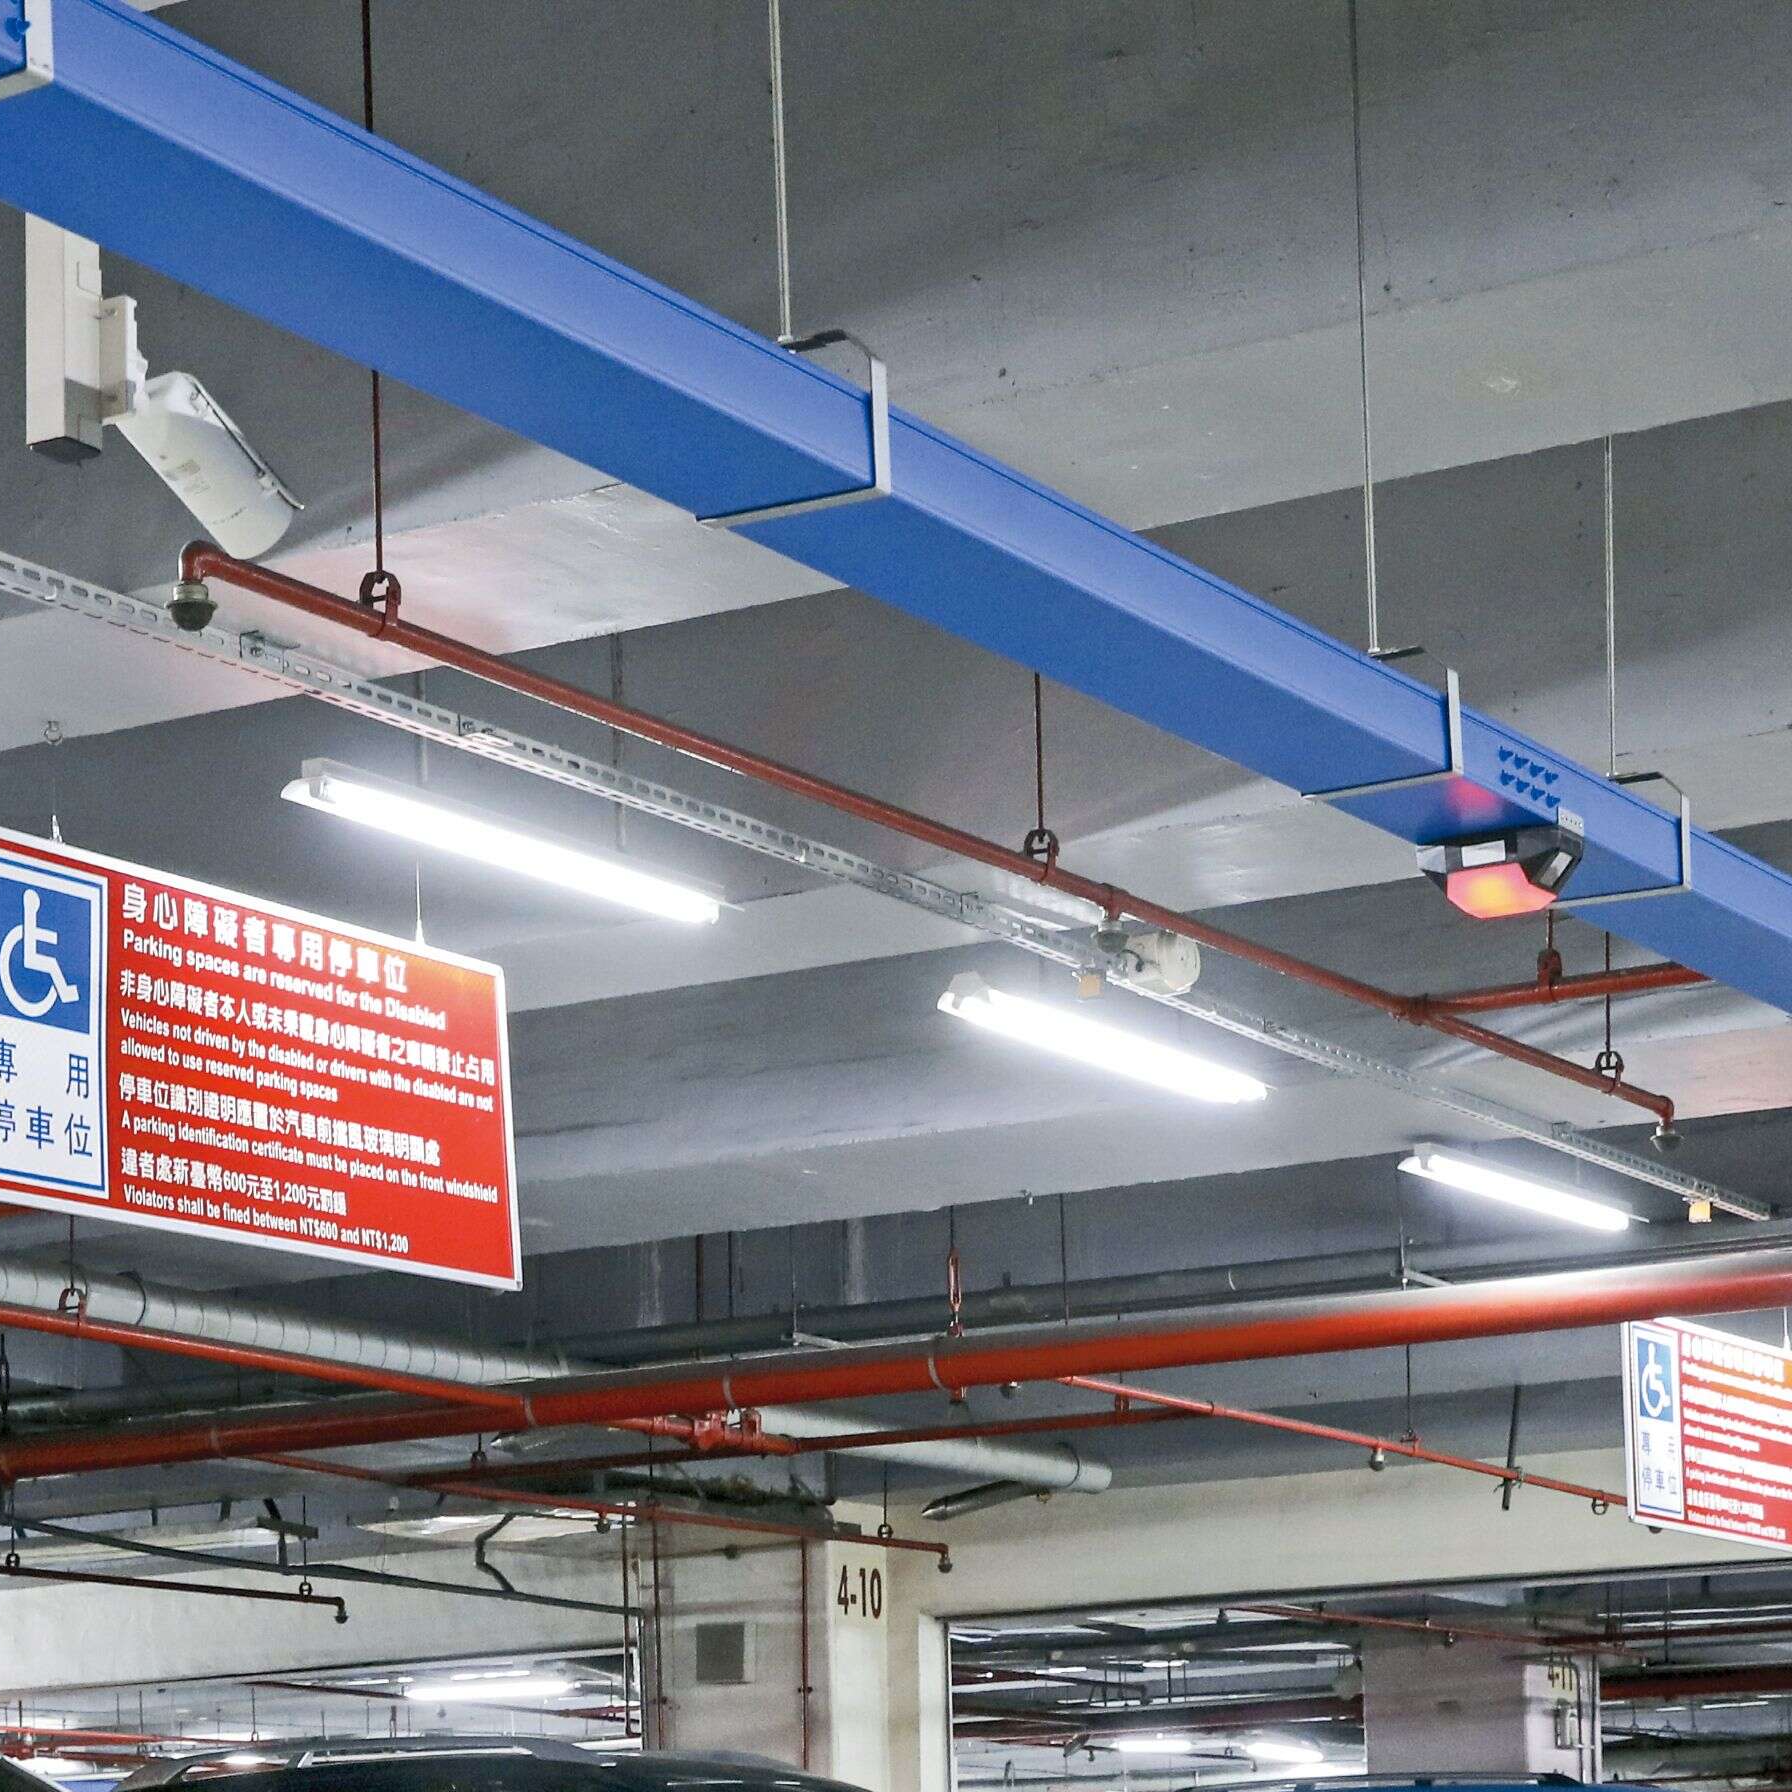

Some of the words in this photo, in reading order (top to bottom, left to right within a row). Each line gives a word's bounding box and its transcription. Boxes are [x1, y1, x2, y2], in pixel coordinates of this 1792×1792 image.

[122, 885, 409, 994] 身心障礙者專用停車位
[123, 928, 183, 968] Parking
[186, 949, 240, 978] spaces
[242, 964, 268, 985] are
[269, 971, 334, 1002] reserved
[335, 983, 358, 1008] for
[358, 991, 383, 1015] the
[384, 996, 446, 1031] Disabled
[120, 1007, 170, 1037] Vehicles
[172, 1024, 192, 1043] not
[193, 1026, 230, 1051] driven
[231, 1033, 246, 1059] by
[247, 1038, 266, 1060] the
[267, 1043, 315, 1071] disabled
[315, 1058, 329, 1074] or
[329, 1058, 368, 1084] drivers
[368, 1068, 392, 1089] with
[392, 1073, 411, 1094] the
[412, 1077, 457, 1104] disabled
[457, 1091, 475, 1108] are
[475, 1095, 494, 1113] not
[120, 1036, 165, 1063] allowed
[167, 1047, 180, 1066] to
[182, 1053, 203, 1072] use
[205, 1058, 254, 1083] reserved
[256, 1070, 298, 1098] parking
[299, 1080, 339, 1103] spaces
[121, 1109, 131, 1130] A
[133, 1115, 176, 1143] parking
[178, 1120, 250, 1154] identification
[251, 1140, 304, 1165] certificate
[305, 1152, 333, 1171] must
[333, 1153, 348, 1174] be
[349, 1158, 384, 1181] placed
[385, 1168, 400, 1184] on
[400, 1167, 418, 1188] the
[418, 1170, 445, 1193] front
[445, 1177, 498, 1204] windshield
[123, 1183, 175, 1211] Violators
[177, 1195, 204, 1216] shall
[206, 1199, 221, 1219] be
[222, 1202, 251, 1225] fined
[252, 1207, 298, 1233] between
[299, 1216, 339, 1241] NT$600
[340, 1227, 360, 1245] and
[361, 1228, 409, 1254] NT$1,200
[838, 1565, 882, 1619] 4-10
